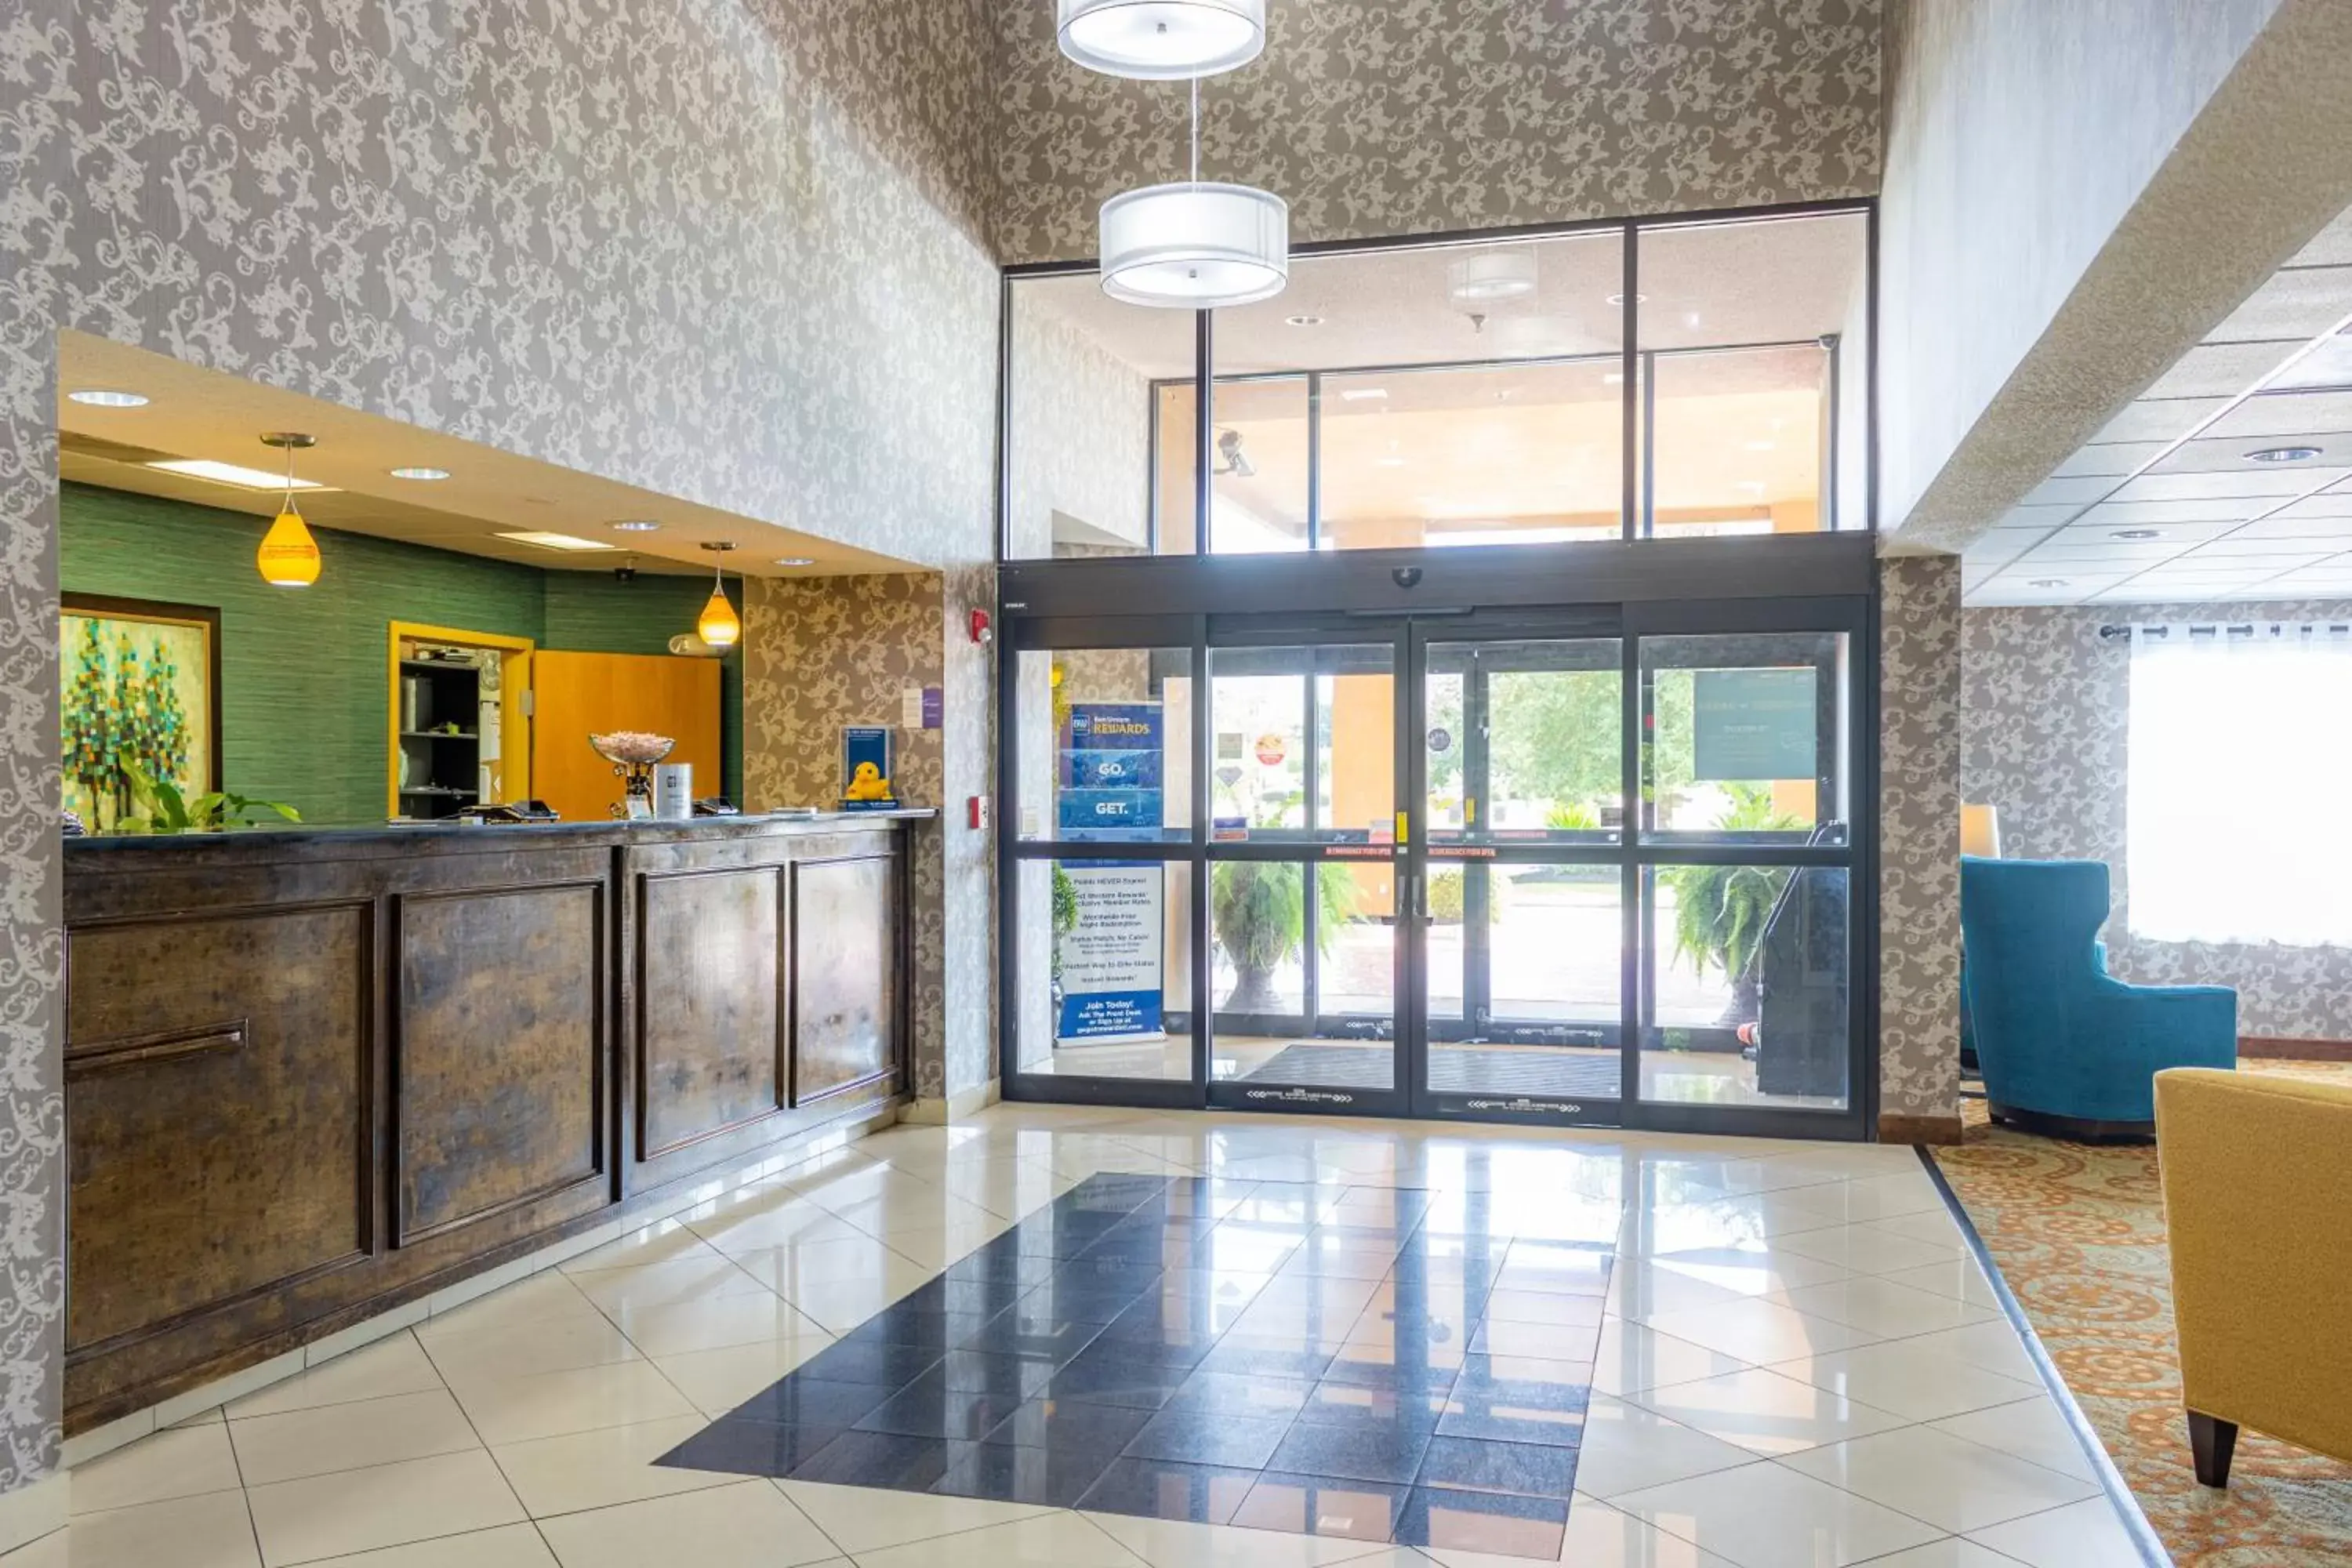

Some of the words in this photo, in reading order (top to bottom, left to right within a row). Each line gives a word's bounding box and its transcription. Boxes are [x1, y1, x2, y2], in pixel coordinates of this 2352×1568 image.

[1094, 724, 1150, 735] REWARDS
[1098, 763, 1126, 776] GO.
[1095, 802, 1128, 815] GET.
[1085, 1001, 1105, 1011] Join
[1105, 1000, 1134, 1009] Today!
